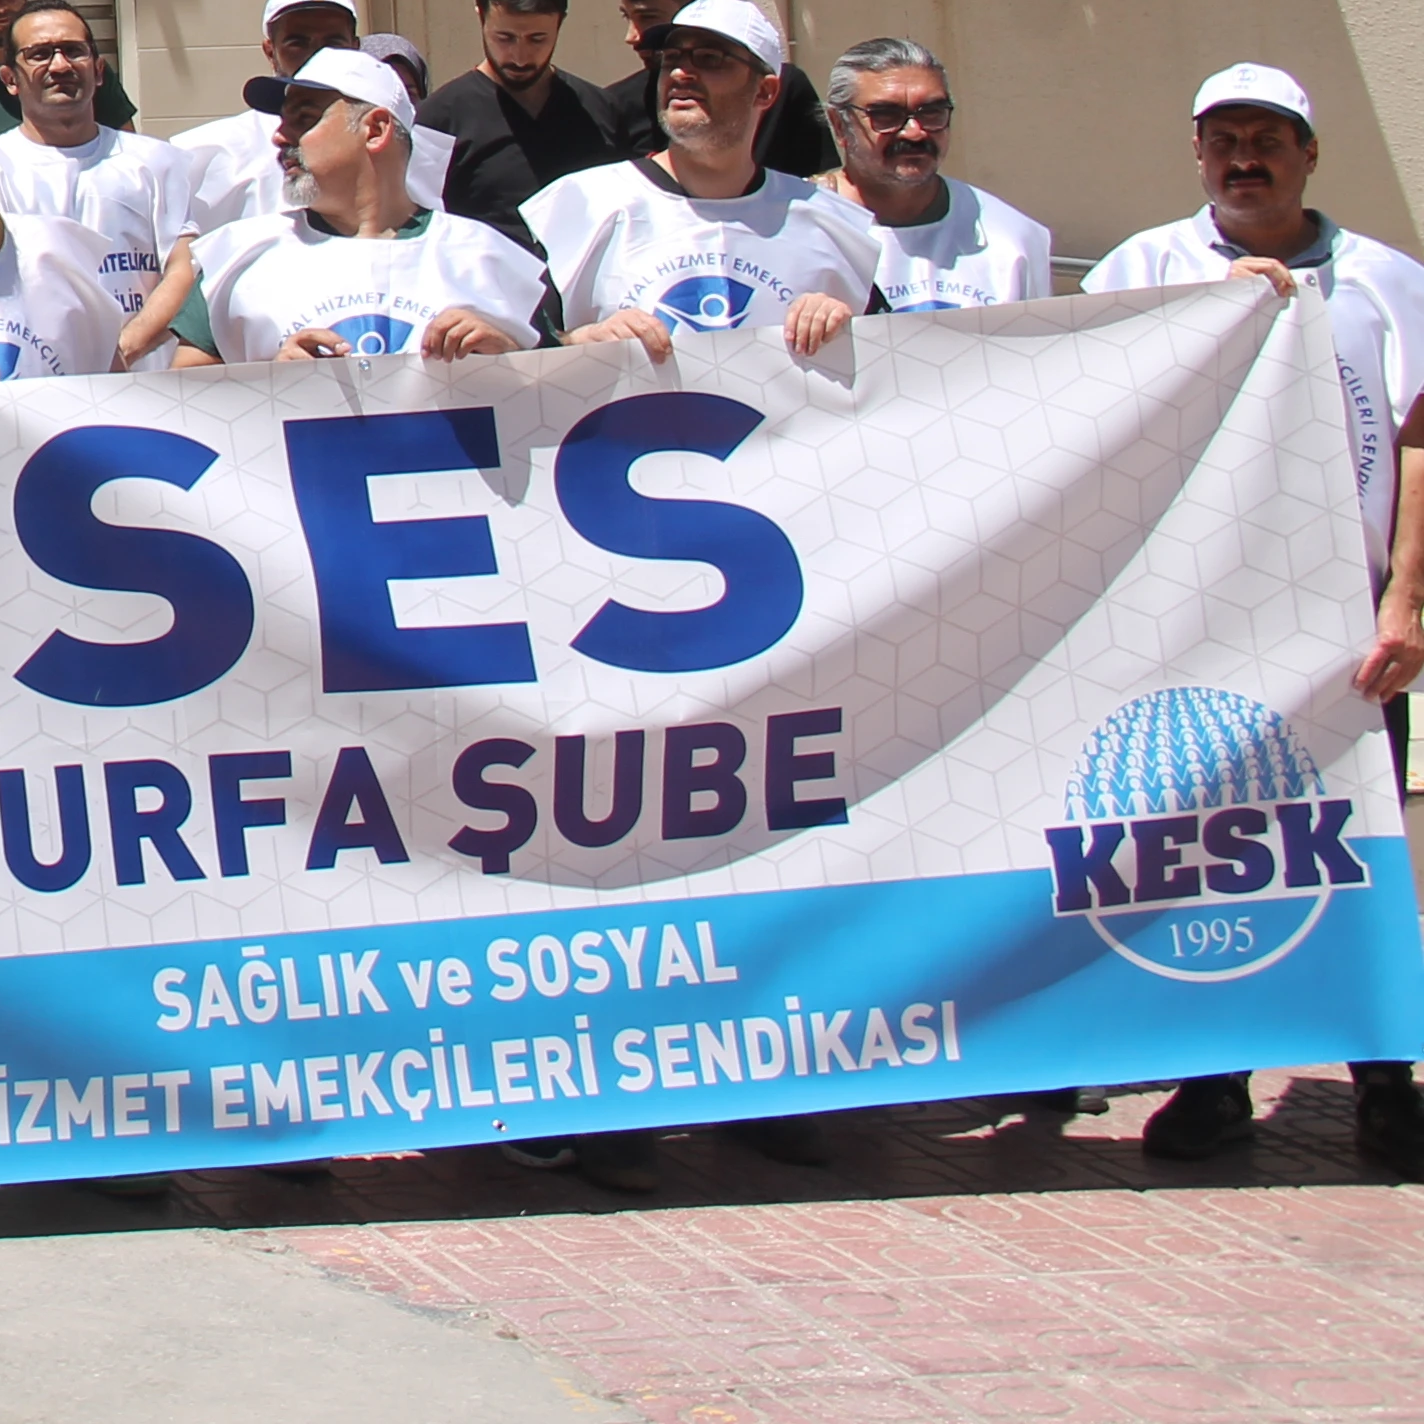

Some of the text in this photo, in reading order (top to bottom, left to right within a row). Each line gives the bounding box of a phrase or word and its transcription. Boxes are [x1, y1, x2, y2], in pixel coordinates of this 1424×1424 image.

[314, 291, 387, 316] HİZMET
[656, 252, 728, 277] HİZMET
[13, 390, 805, 709] SES
[448, 707, 850, 876] ŞUBE
[1043, 798, 1371, 913] KESK
[151, 919, 738, 1032] SAĞLIK ve SOSYAL
[1168, 916, 1255, 958] 1995
[210, 1014, 599, 1131] EMEKÇİLERİ
[615, 995, 961, 1092] SENDİKASI
